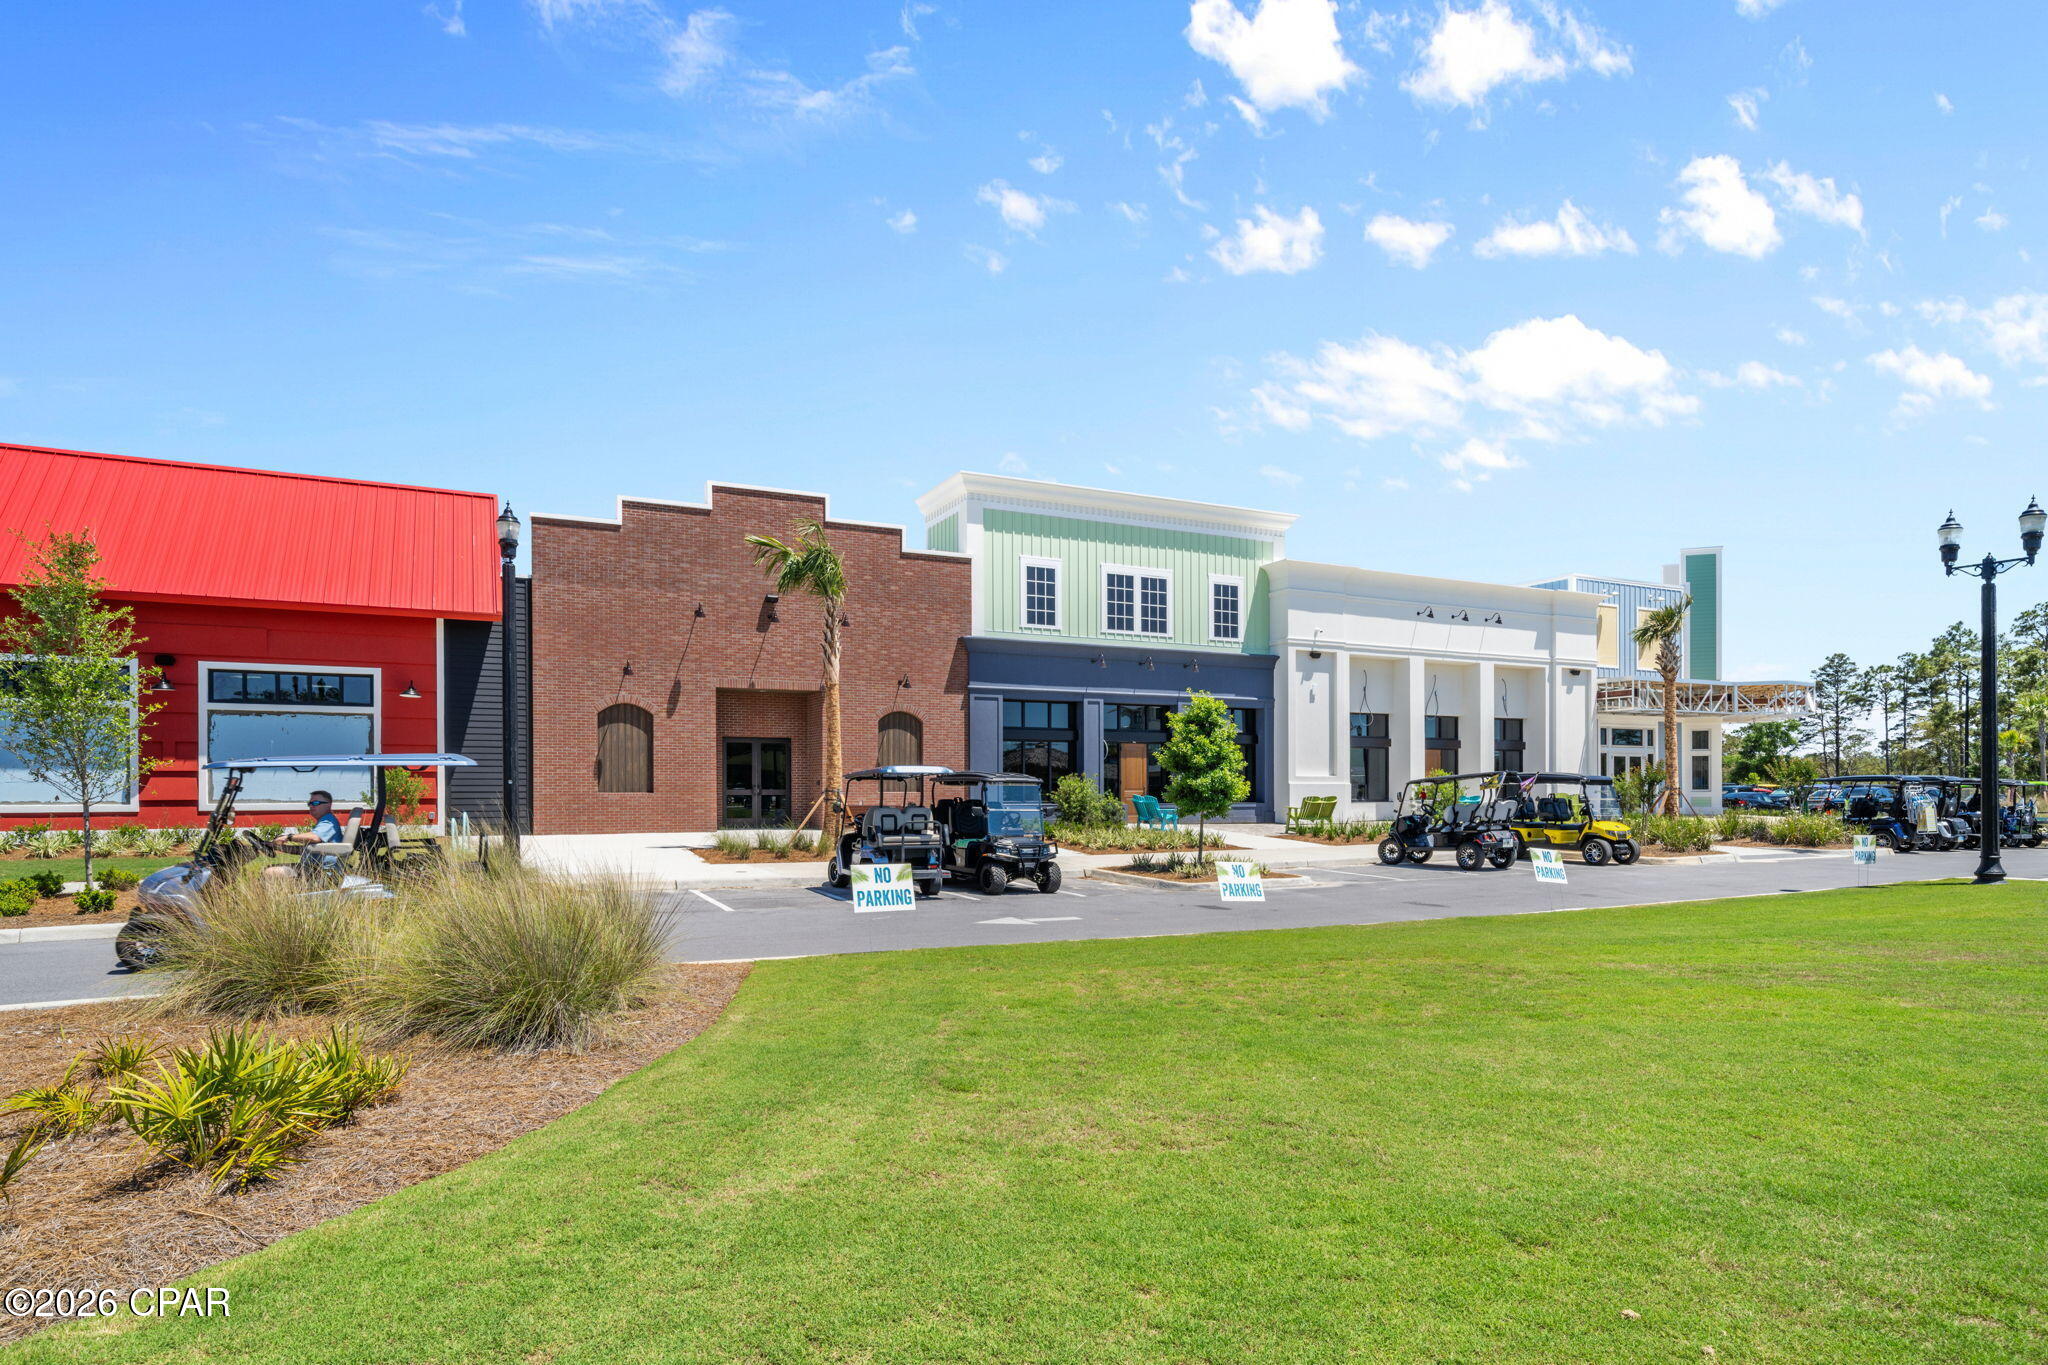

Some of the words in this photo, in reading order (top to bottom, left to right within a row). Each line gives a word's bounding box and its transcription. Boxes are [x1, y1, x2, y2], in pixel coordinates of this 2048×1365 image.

[1861, 836, 1869, 848] NO
[1541, 850, 1553, 863] NO
[1854, 850, 1877, 862] PARKING
[874, 867, 891, 883] NO
[1231, 864, 1246, 879] NO
[1535, 866, 1566, 880] PARKING
[1222, 883, 1263, 897] PARKING
[857, 889, 912, 907] PARKING
